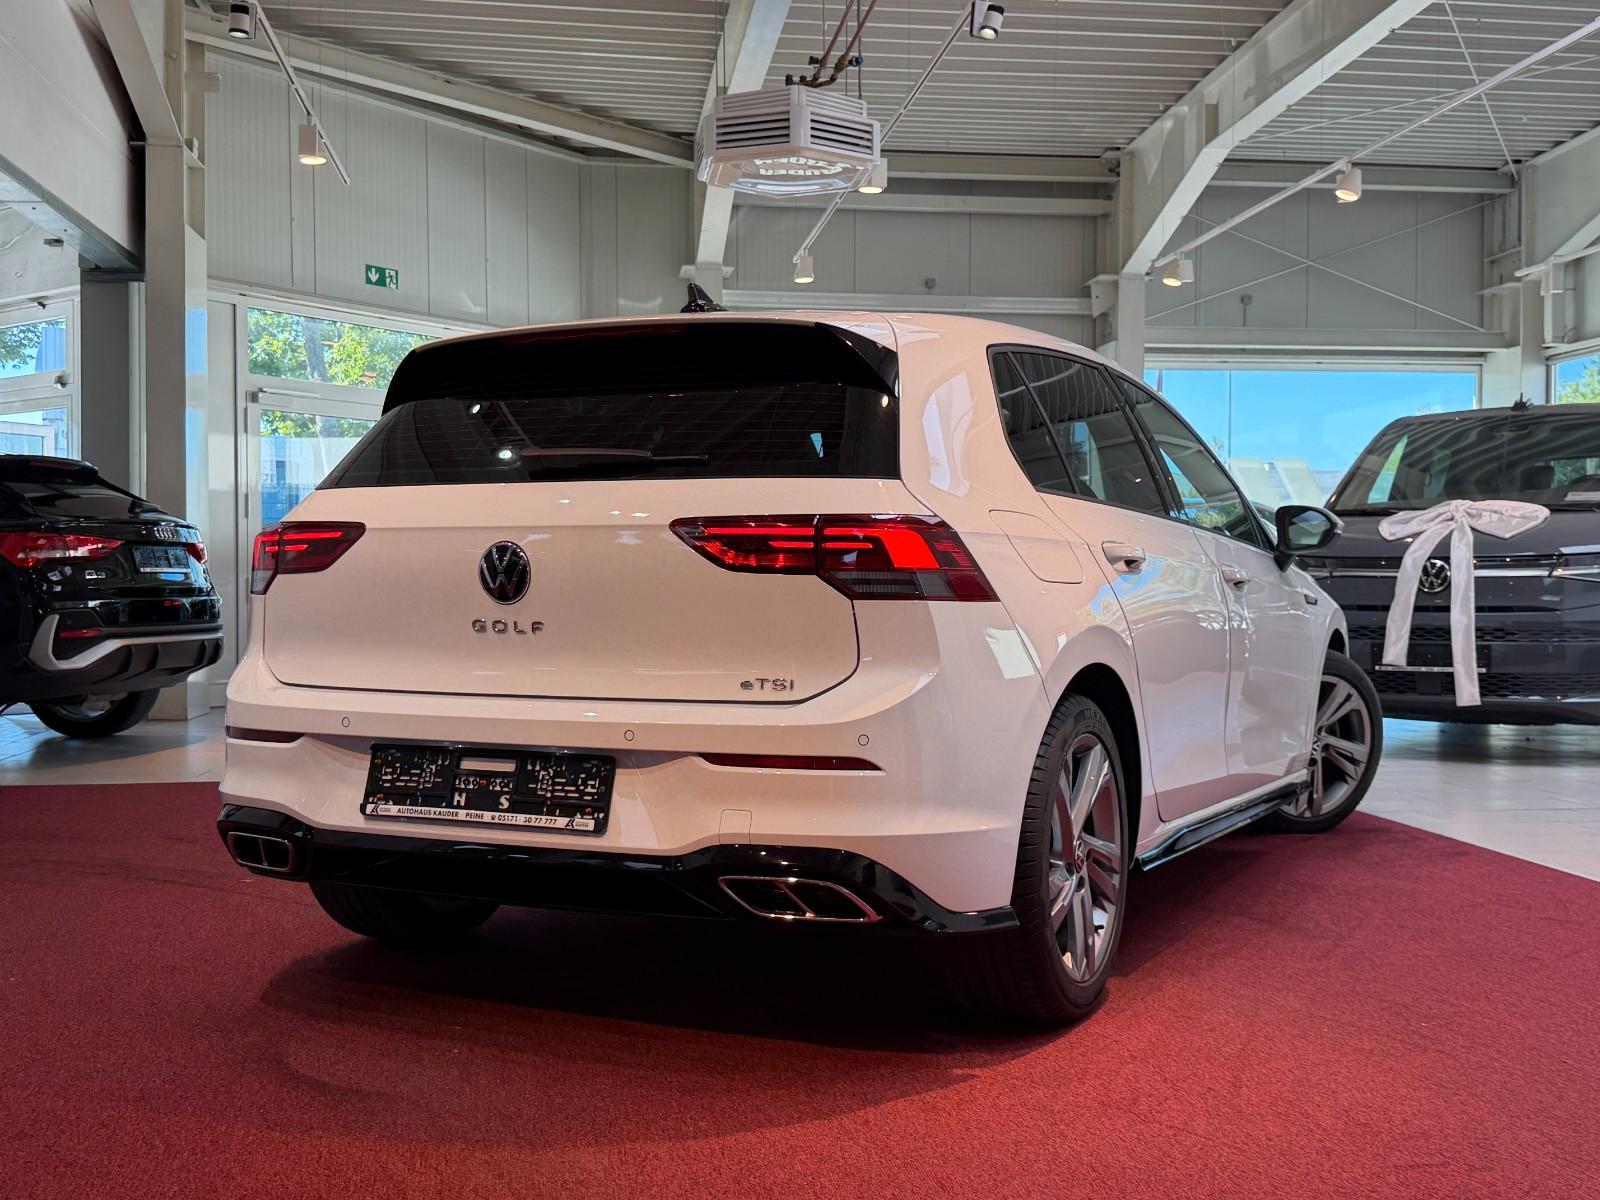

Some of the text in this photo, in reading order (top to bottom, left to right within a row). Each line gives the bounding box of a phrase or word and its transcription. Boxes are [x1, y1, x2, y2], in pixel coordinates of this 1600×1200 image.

[472, 618, 545, 634] GOLF
[740, 678, 794, 691] eTSI
[397, 807, 432, 816] AUTOHAUS
[433, 809, 459, 818] KAUDER
[465, 812, 485, 820] PEINE
